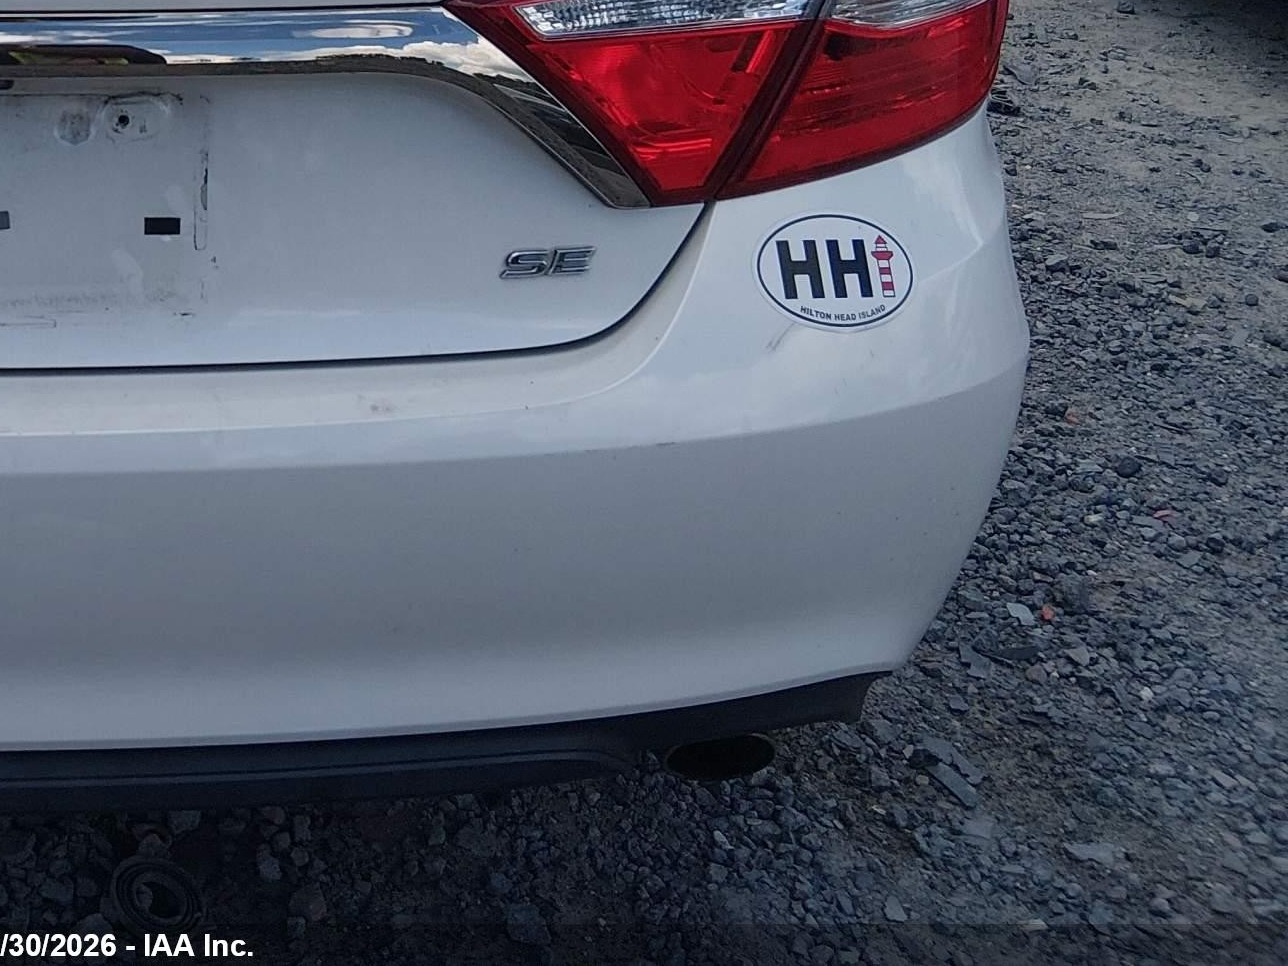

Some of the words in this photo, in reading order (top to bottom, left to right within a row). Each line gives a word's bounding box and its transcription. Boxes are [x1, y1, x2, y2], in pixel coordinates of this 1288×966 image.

[499, 245, 597, 280] SE
[800, 305, 832, 321] HILTON
[834, 313, 857, 322] HEAD
[858, 304, 886, 320] ISLAND
